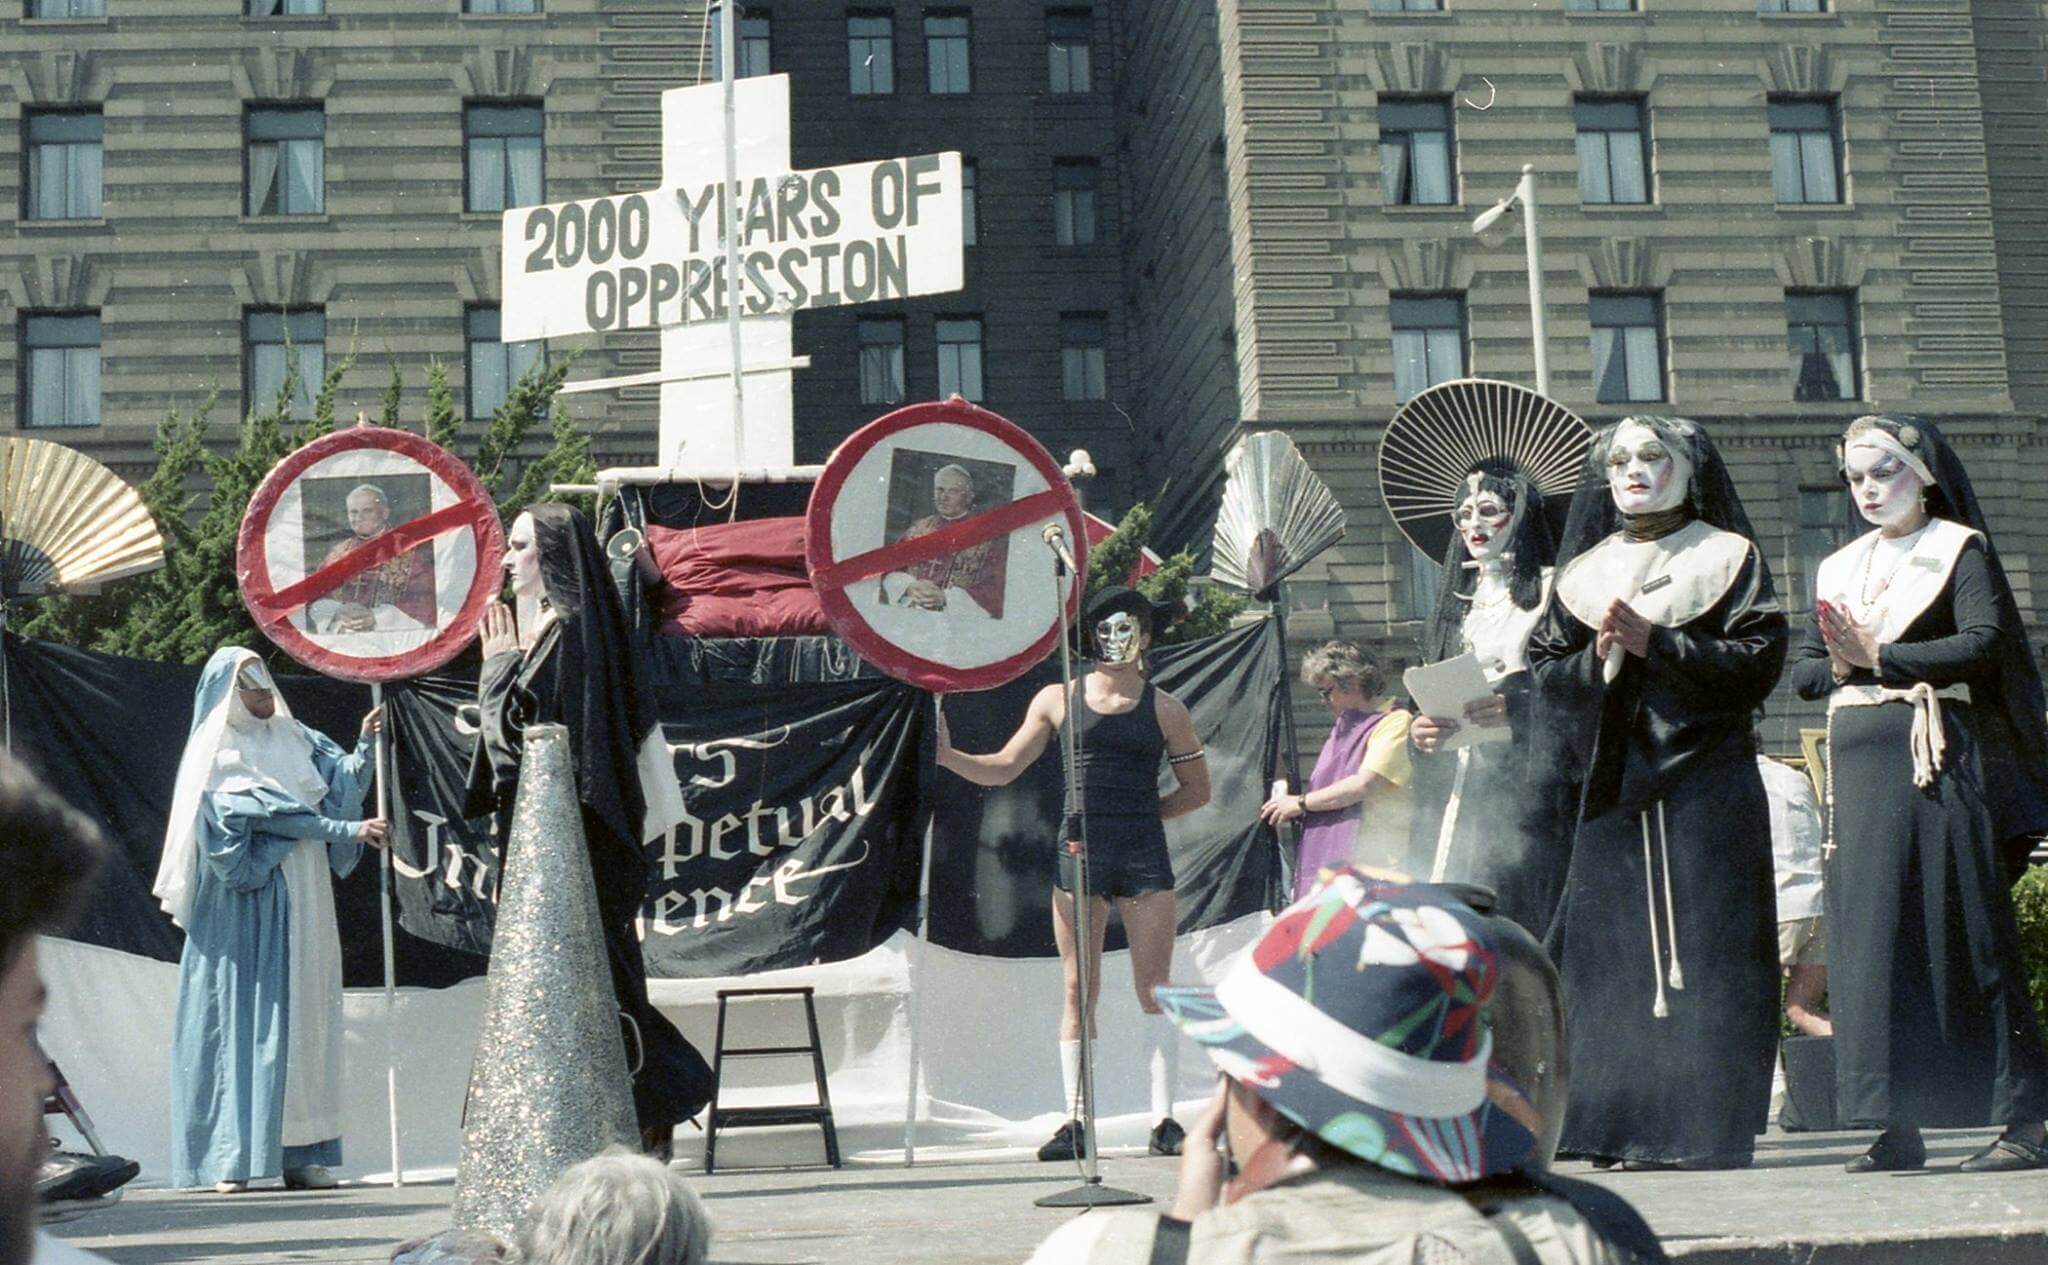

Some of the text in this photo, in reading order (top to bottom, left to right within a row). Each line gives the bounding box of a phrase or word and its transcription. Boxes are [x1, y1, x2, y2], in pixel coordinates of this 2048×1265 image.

[525, 154, 941, 273] 2000 YEARS OF
[586, 235, 909, 331] OPPRESSION
[656, 741, 875, 880] petual
